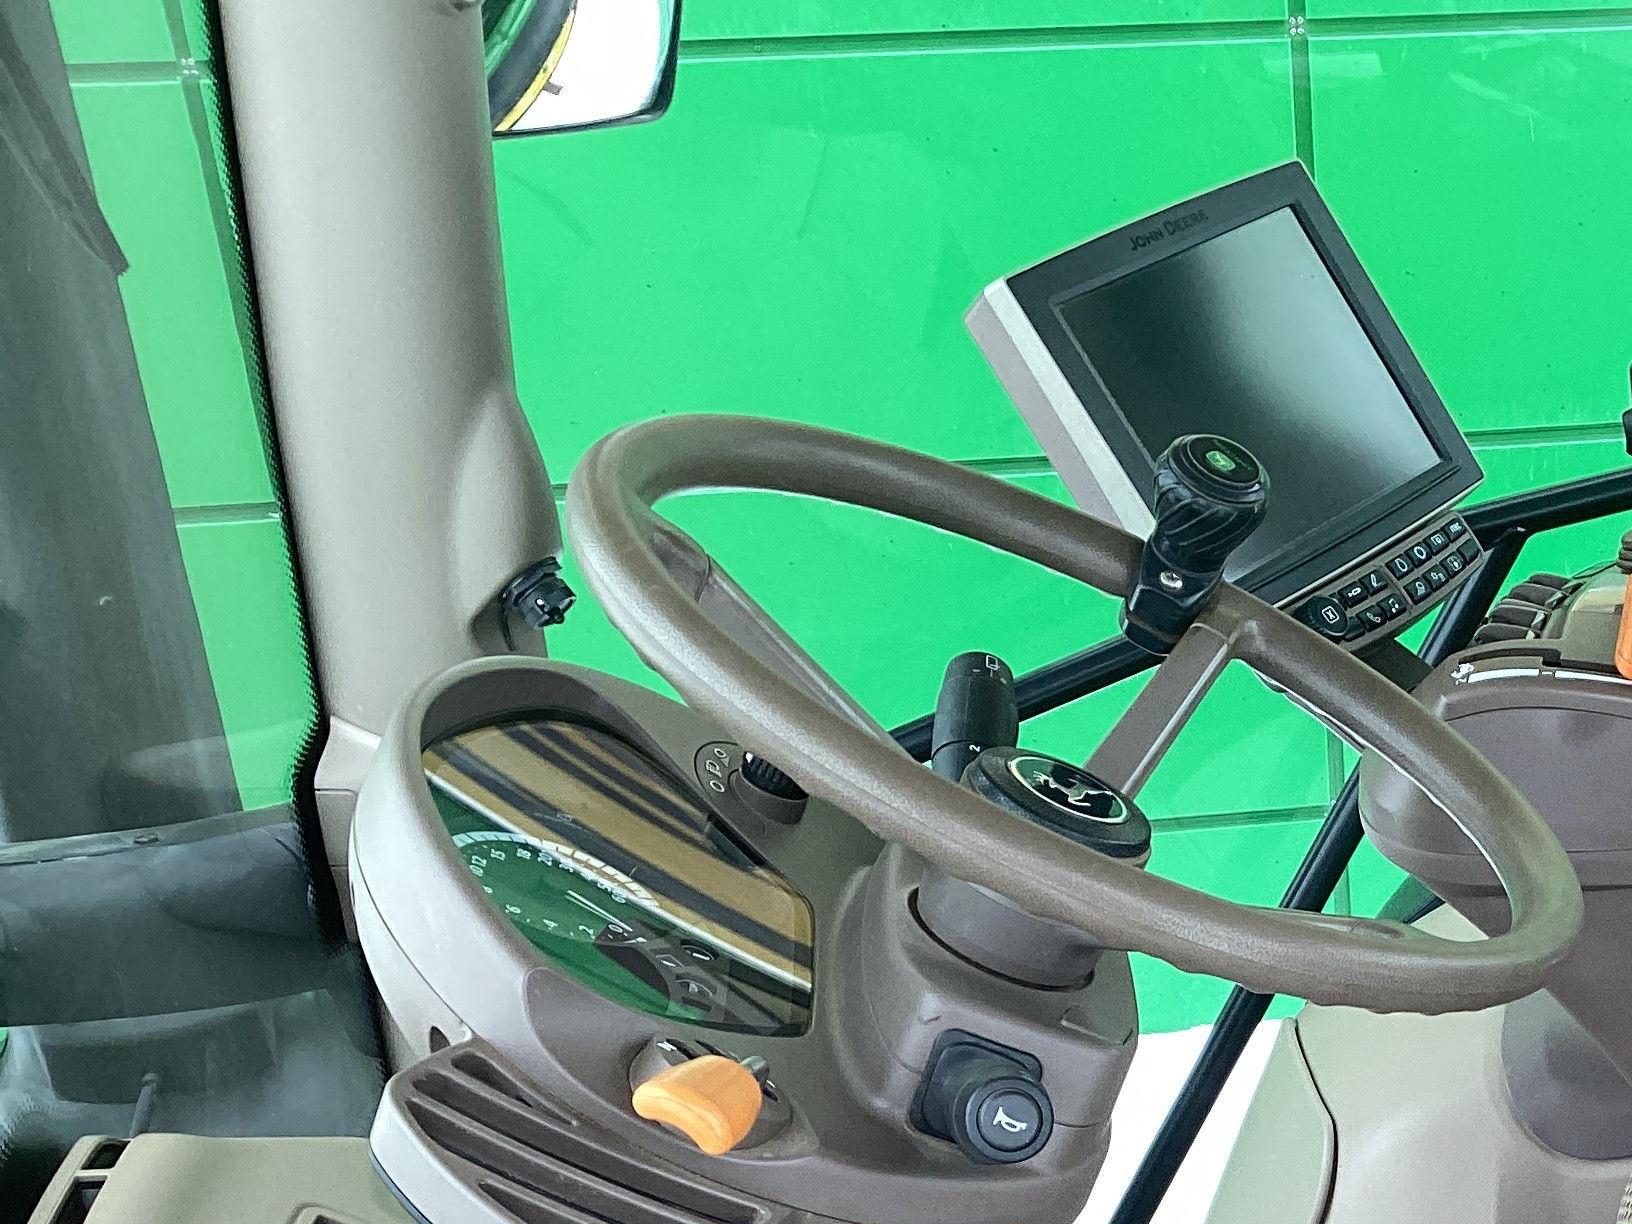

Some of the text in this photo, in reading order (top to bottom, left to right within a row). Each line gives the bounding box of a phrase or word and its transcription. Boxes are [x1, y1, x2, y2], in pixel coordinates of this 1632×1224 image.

[1129, 208, 1209, 251] JOHN DEERE
[968, 744, 981, 753] 2
[506, 904, 521, 914] 6
